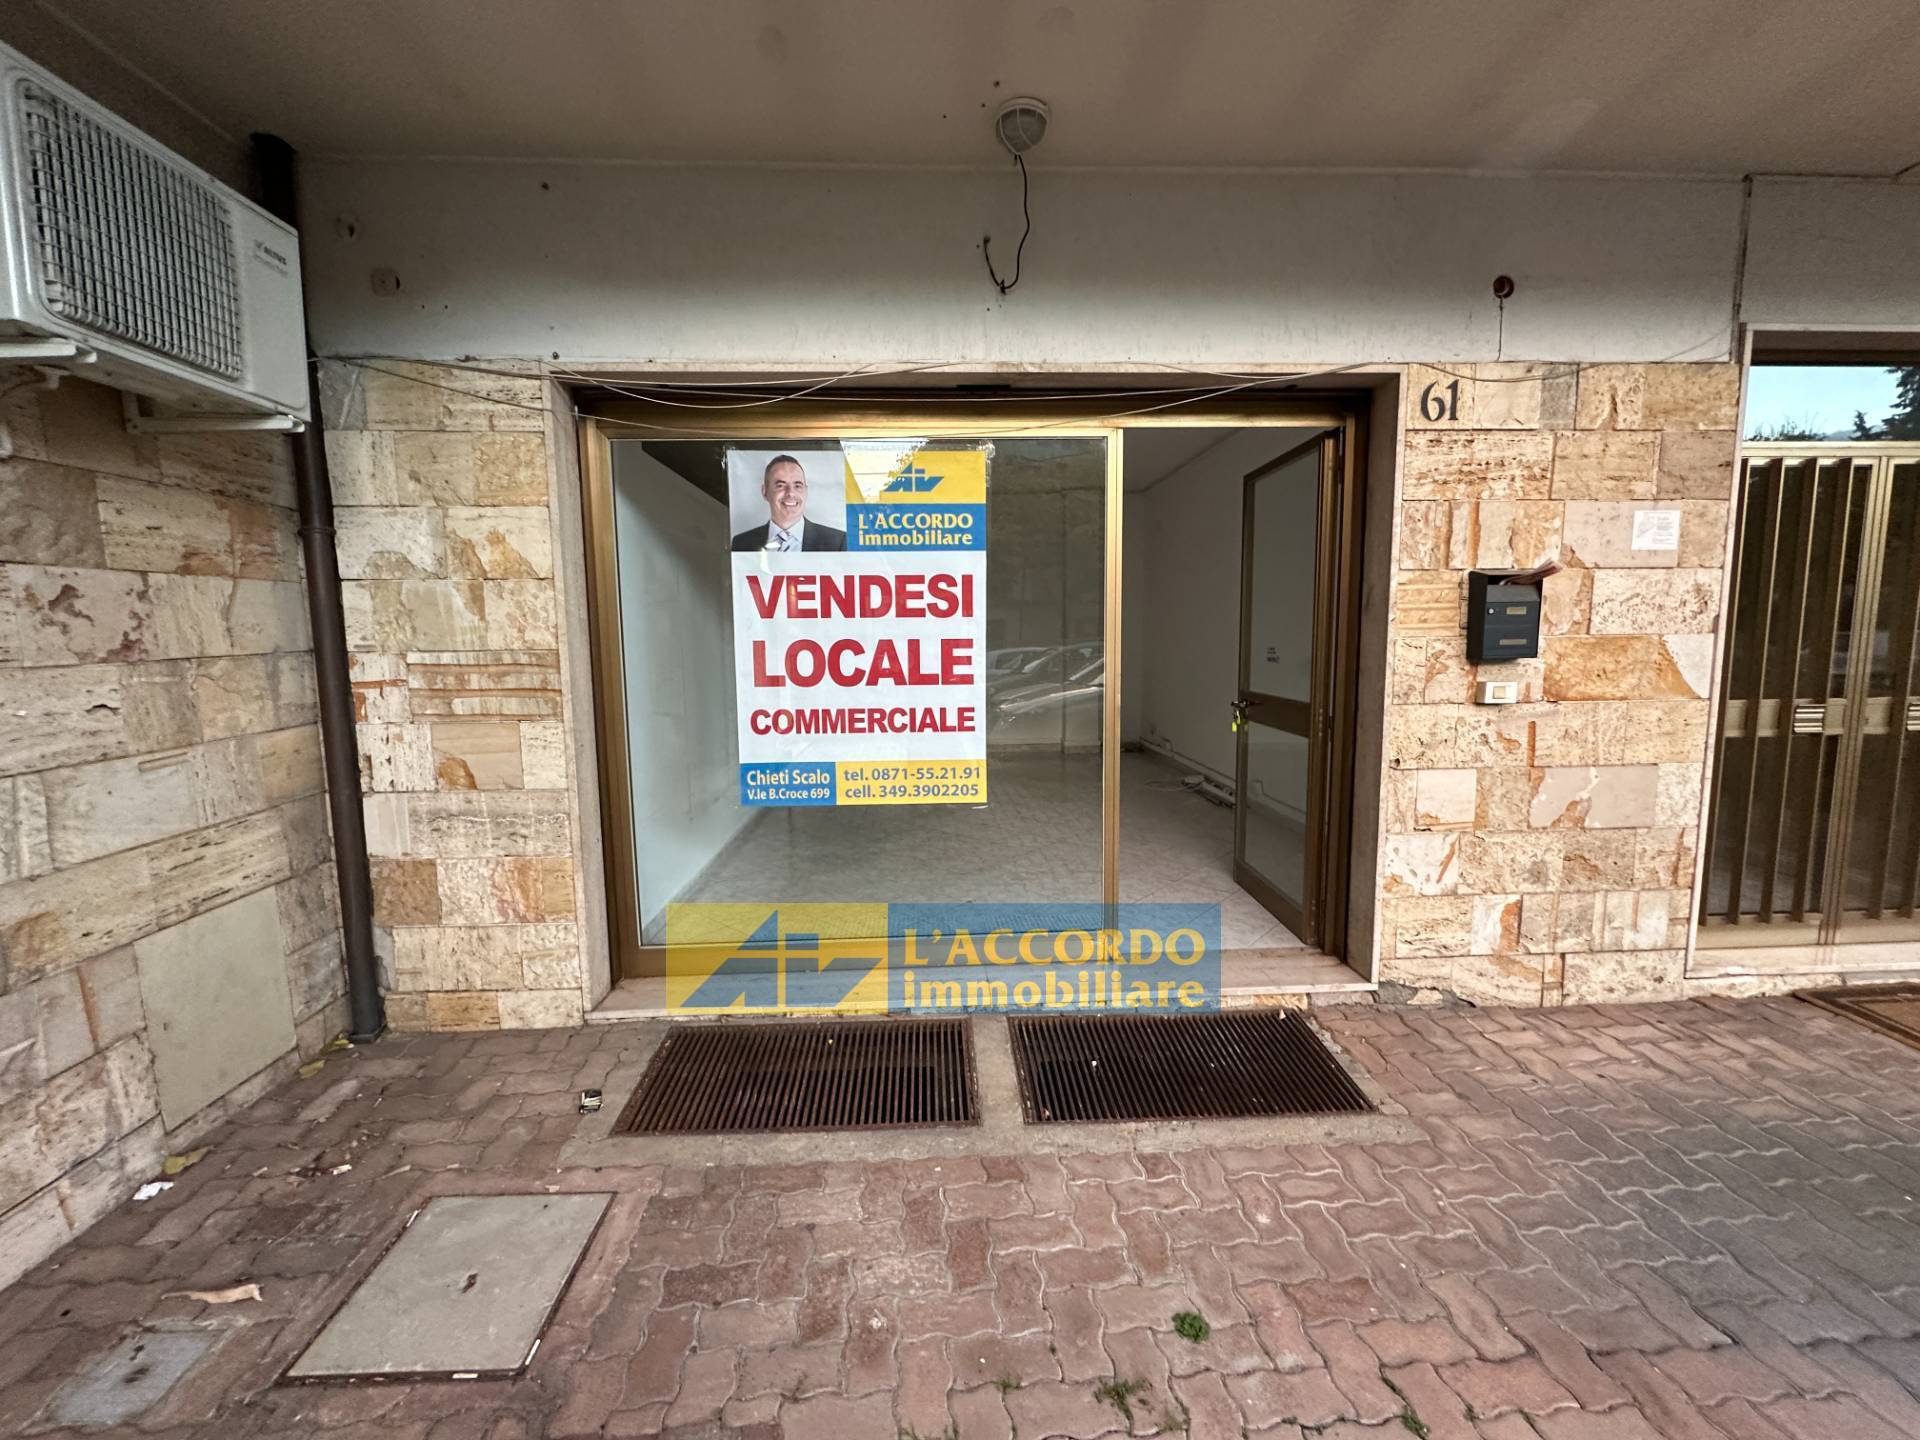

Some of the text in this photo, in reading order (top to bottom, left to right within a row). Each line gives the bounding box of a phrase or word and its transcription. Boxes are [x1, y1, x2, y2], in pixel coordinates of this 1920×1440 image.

[1421, 379, 1459, 421] 61
[858, 513, 973, 529] L'ACCORDO
[858, 530, 973, 545] immobiliare
[746, 574, 973, 619] VENDESI
[753, 638, 974, 687] LOCALE
[750, 707, 975, 735] COMMERCIALE
[746, 768, 830, 785] Chieti Scalo
[844, 767, 980, 781] tel. 0871-55.21.91
[747, 787, 830, 800] V.le B.Croce 699
[845, 783, 978, 798] cell. 349.3902205
